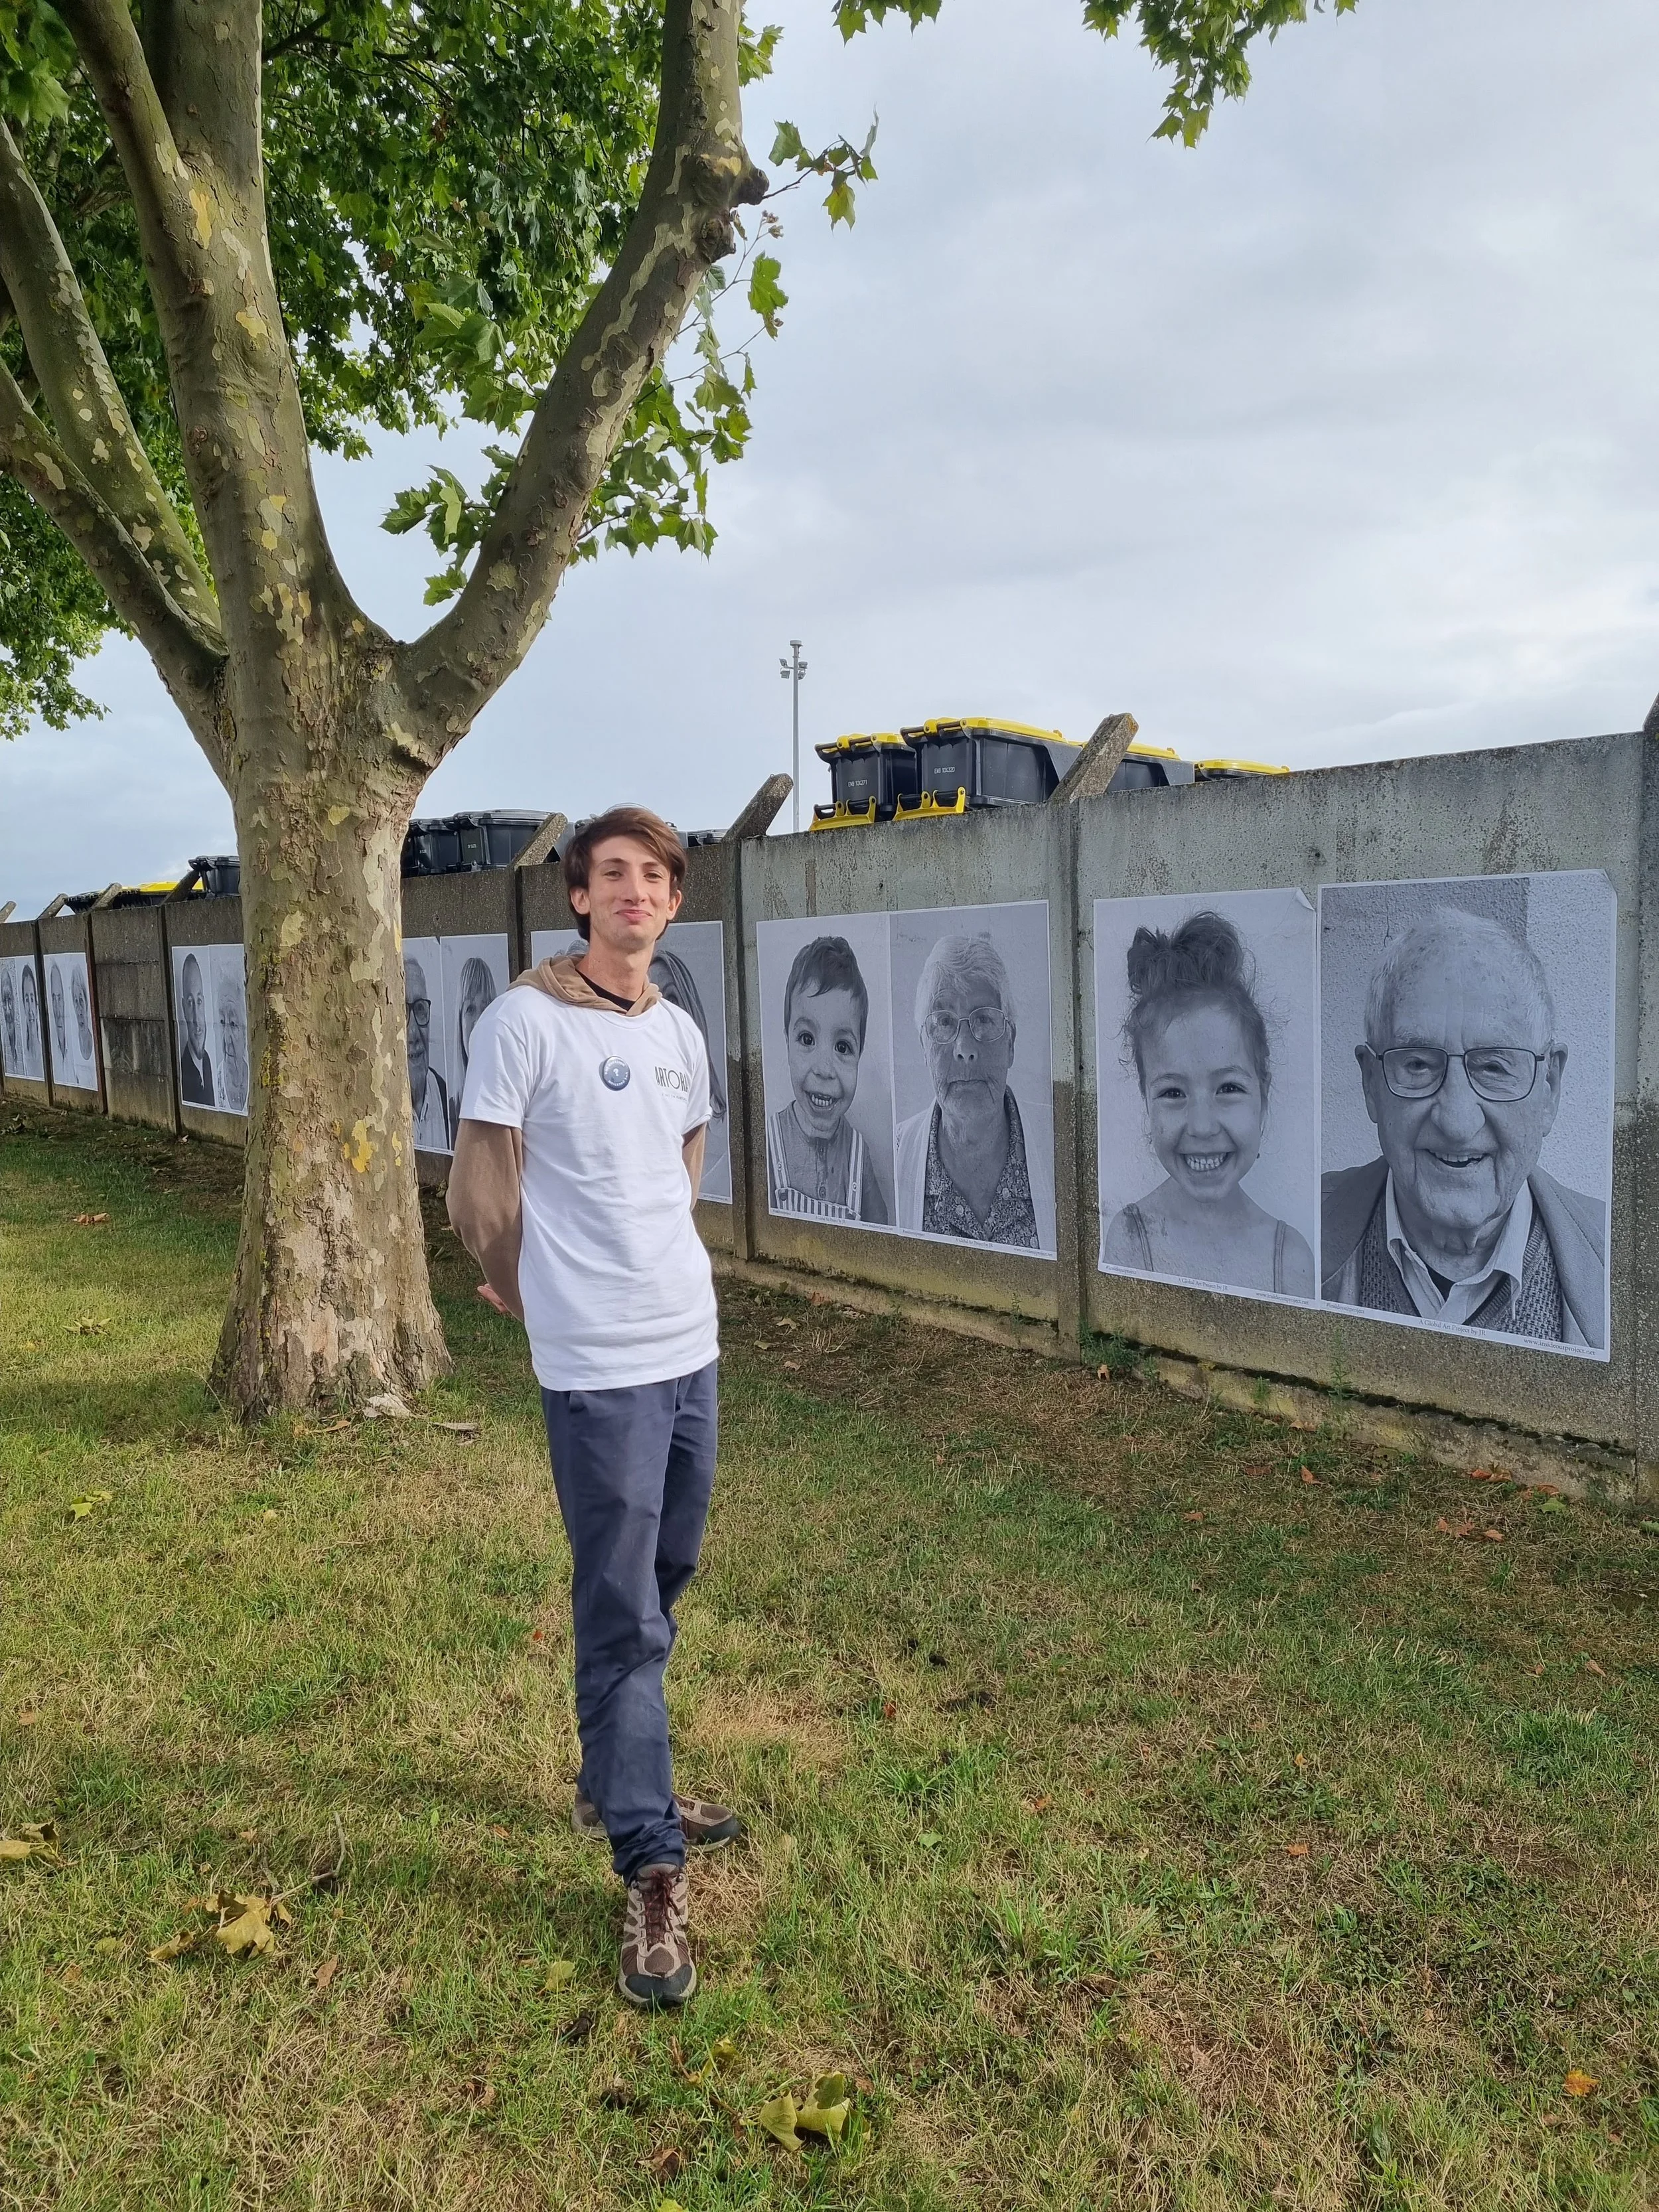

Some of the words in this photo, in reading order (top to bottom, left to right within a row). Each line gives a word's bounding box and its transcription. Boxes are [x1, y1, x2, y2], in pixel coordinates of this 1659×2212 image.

[1424, 1319, 1441, 1328] Global
[1452, 1324, 1469, 1334] Project
[1471, 1327, 1477, 1336] by
[1524, 1338, 1596, 1355] www.insideoutproject.net
